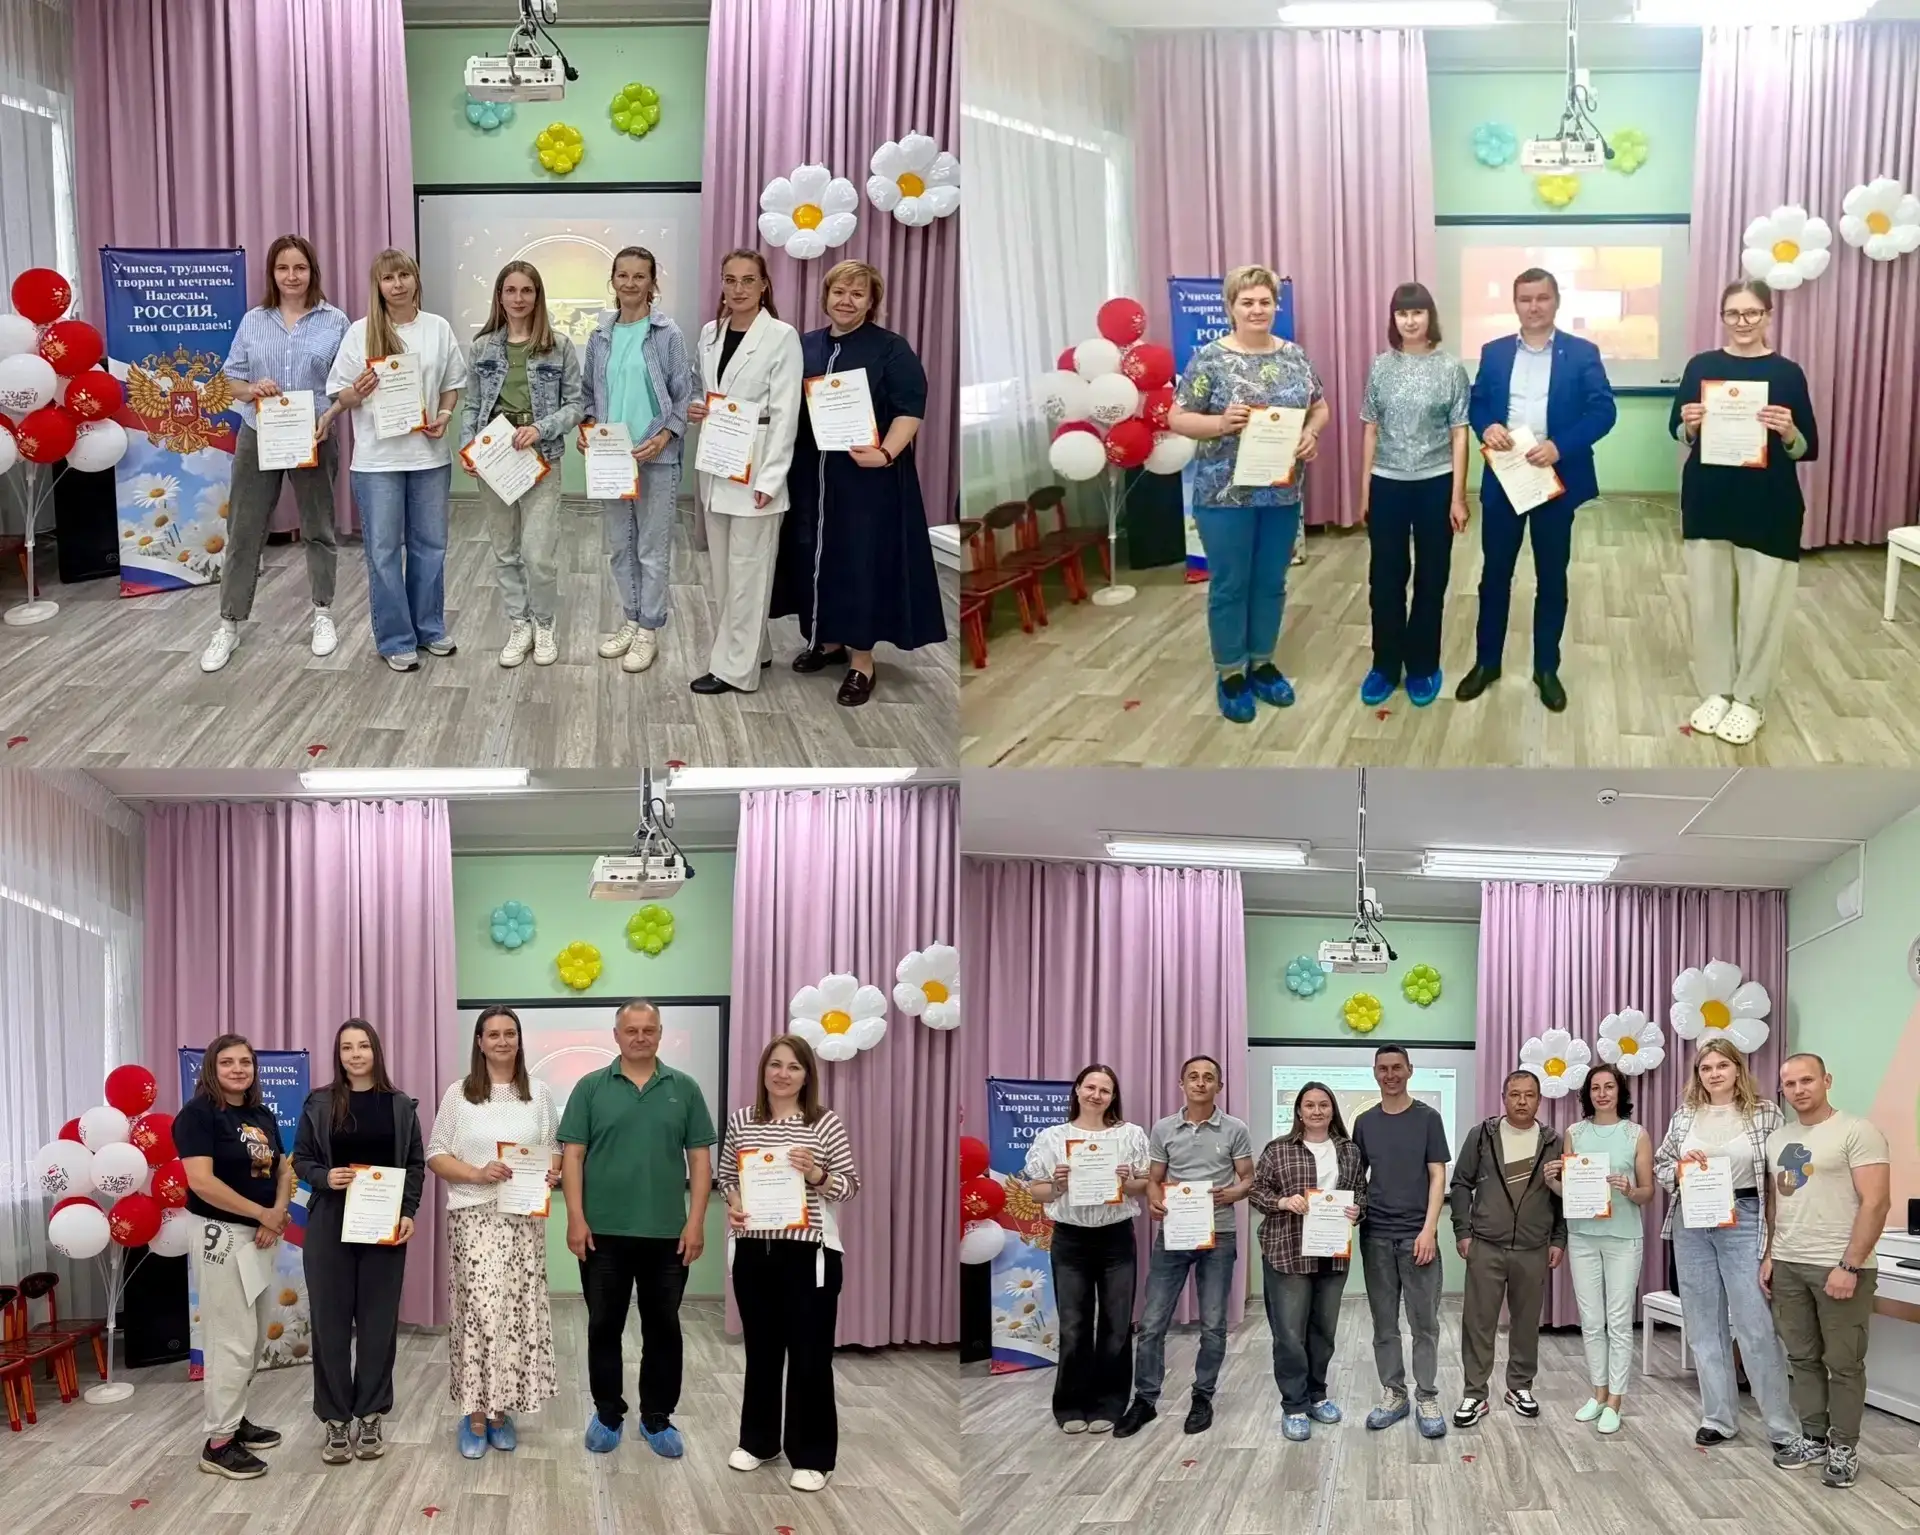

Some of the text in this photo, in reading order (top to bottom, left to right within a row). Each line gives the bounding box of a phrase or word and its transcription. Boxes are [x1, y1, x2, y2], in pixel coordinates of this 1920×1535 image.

[112, 263, 233, 276] Учимся, трудимся,
[116, 277, 235, 289] творим и мечтаем.
[145, 290, 209, 301] Надежды,
[133, 304, 218, 320] РОССИЯ,
[1182, 305, 1223, 315] творим
[127, 320, 232, 334] твои оправдаем!
[996, 1091, 1043, 1102] Учимся,
[998, 1104, 1040, 1114] творим
